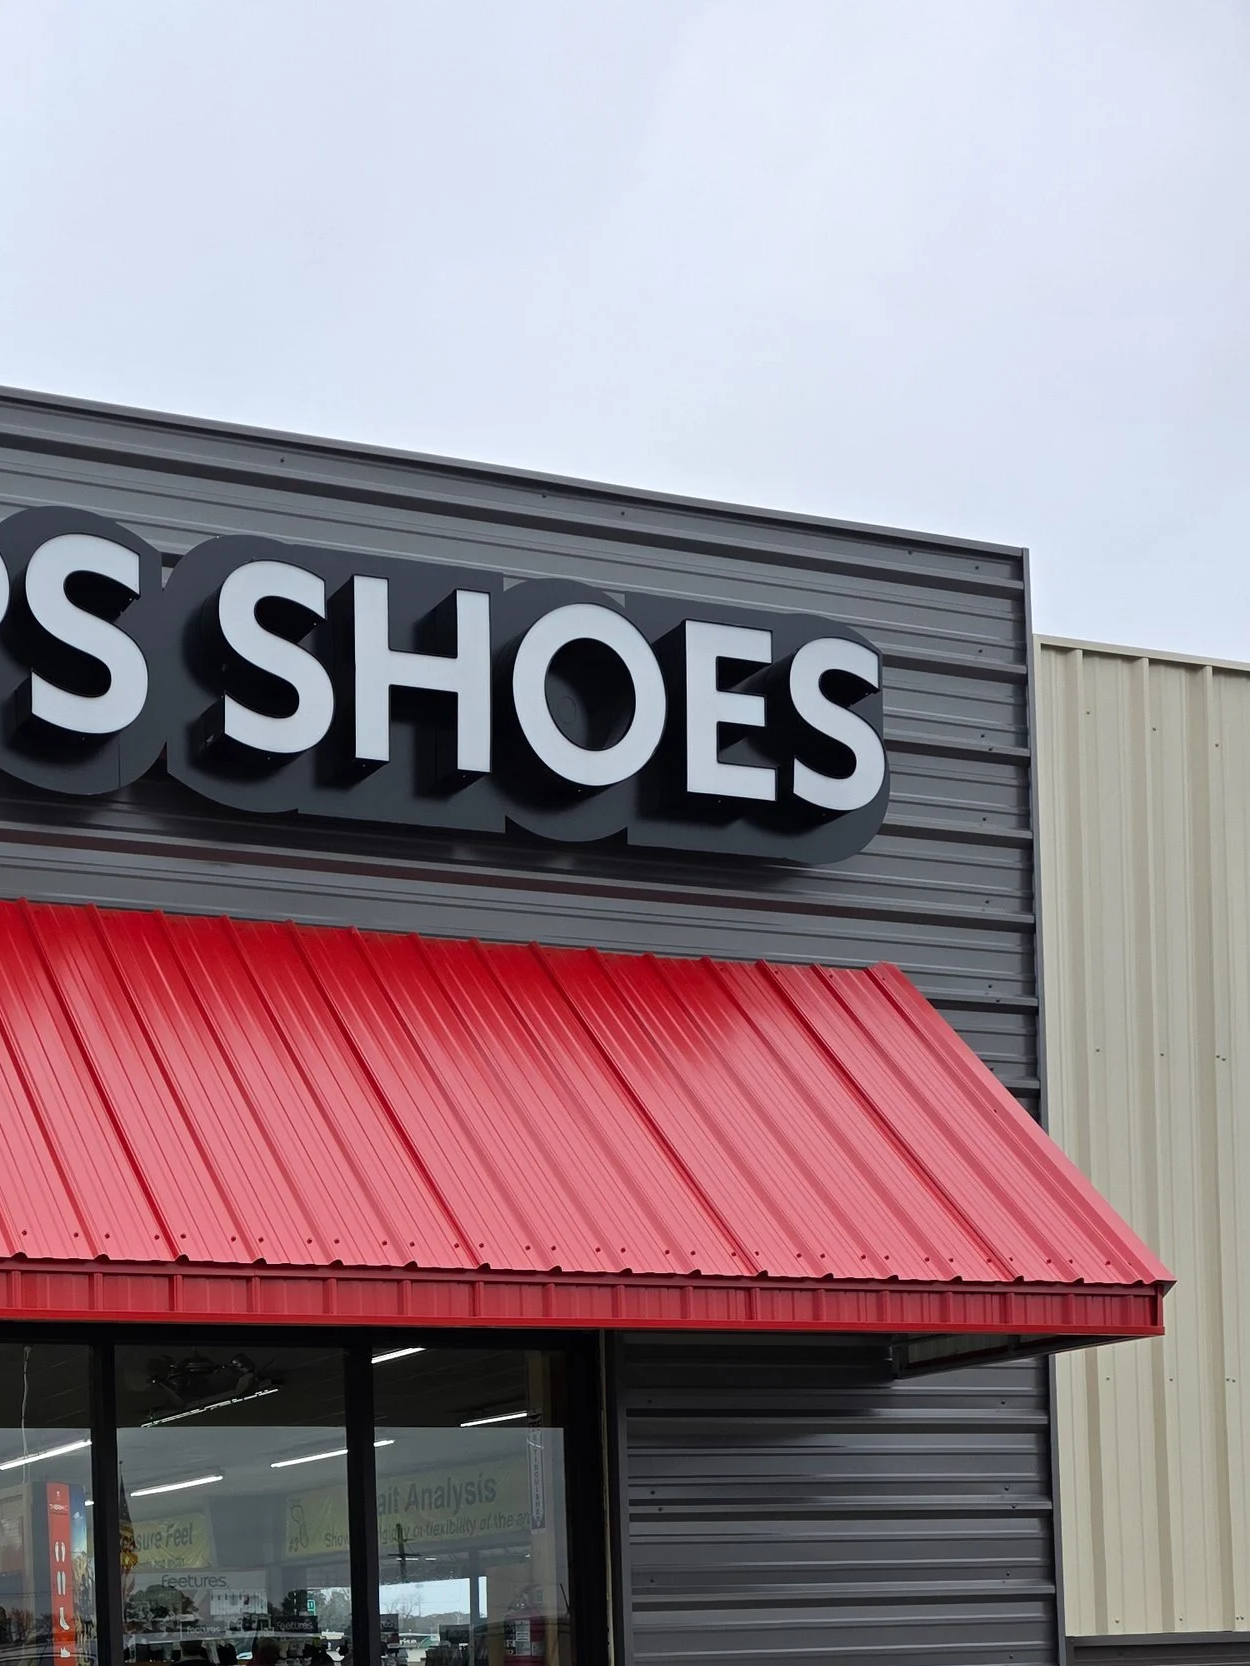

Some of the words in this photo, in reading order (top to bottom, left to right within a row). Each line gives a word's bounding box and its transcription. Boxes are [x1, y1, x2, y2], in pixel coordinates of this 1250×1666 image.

[218, 559, 886, 811] SHOES
[378, 1485, 400, 1517] ait
[404, 1472, 498, 1517] Analysis
